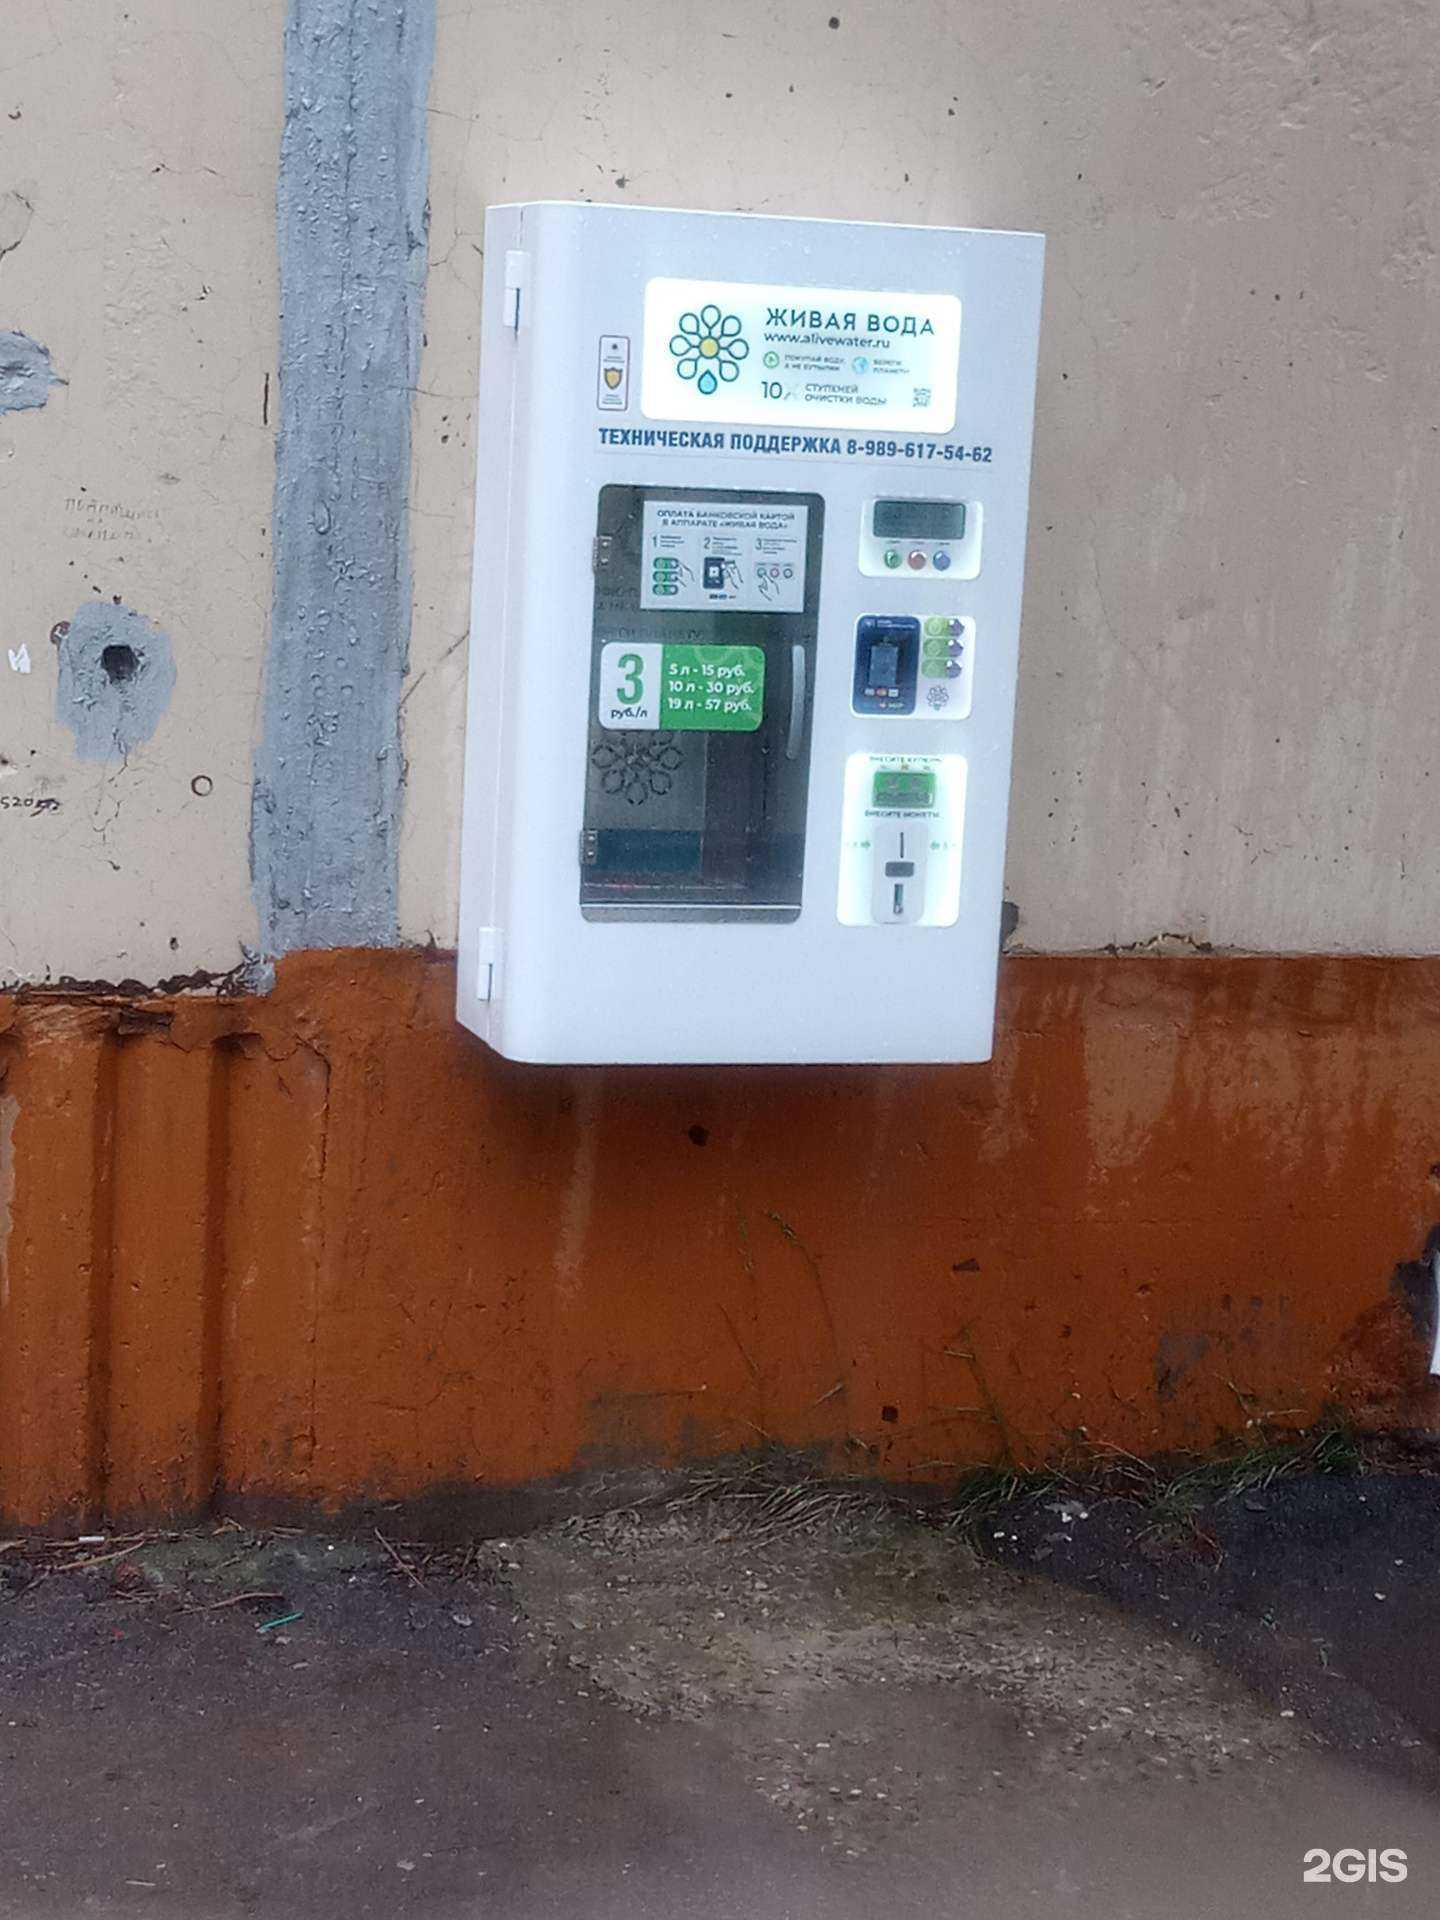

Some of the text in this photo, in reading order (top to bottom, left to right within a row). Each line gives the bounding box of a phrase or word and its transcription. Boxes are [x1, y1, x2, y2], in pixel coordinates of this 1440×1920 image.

[765, 307, 936, 336] ЖИВАЯ ВОДА
[764, 332, 891, 349] www.alivewater.ru
[805, 394, 887, 406] ОЧИСТКИ ВОДЫ
[598, 428, 993, 463] ТЕХНИЧЕСКАЯ ПОДДЕРЖКА 8-989-617-54-62
[657, 509, 796, 522] ОПЛАТА БАНКОВСКОЙ КАРТОЙ
[670, 519, 718, 528] АППАРАТЕ
[703, 537, 711, 550] 2
[755, 538, 763, 551] 3
[668, 663, 679, 676] 5
[680, 665, 690, 675] л
[702, 664, 715, 676] 15
[717, 664, 746, 678] руб.
[616, 653, 645, 705] 3
[669, 681, 683, 692] 10
[685, 682, 696, 692] л
[706, 681, 724, 693] 30
[726, 681, 755, 695] руб.
[667, 698, 682, 709] 19
[684, 699, 694, 710] л
[705, 698, 722, 710] 57
[723, 699, 752, 713] руб.
[610, 706, 649, 721] руб./л
